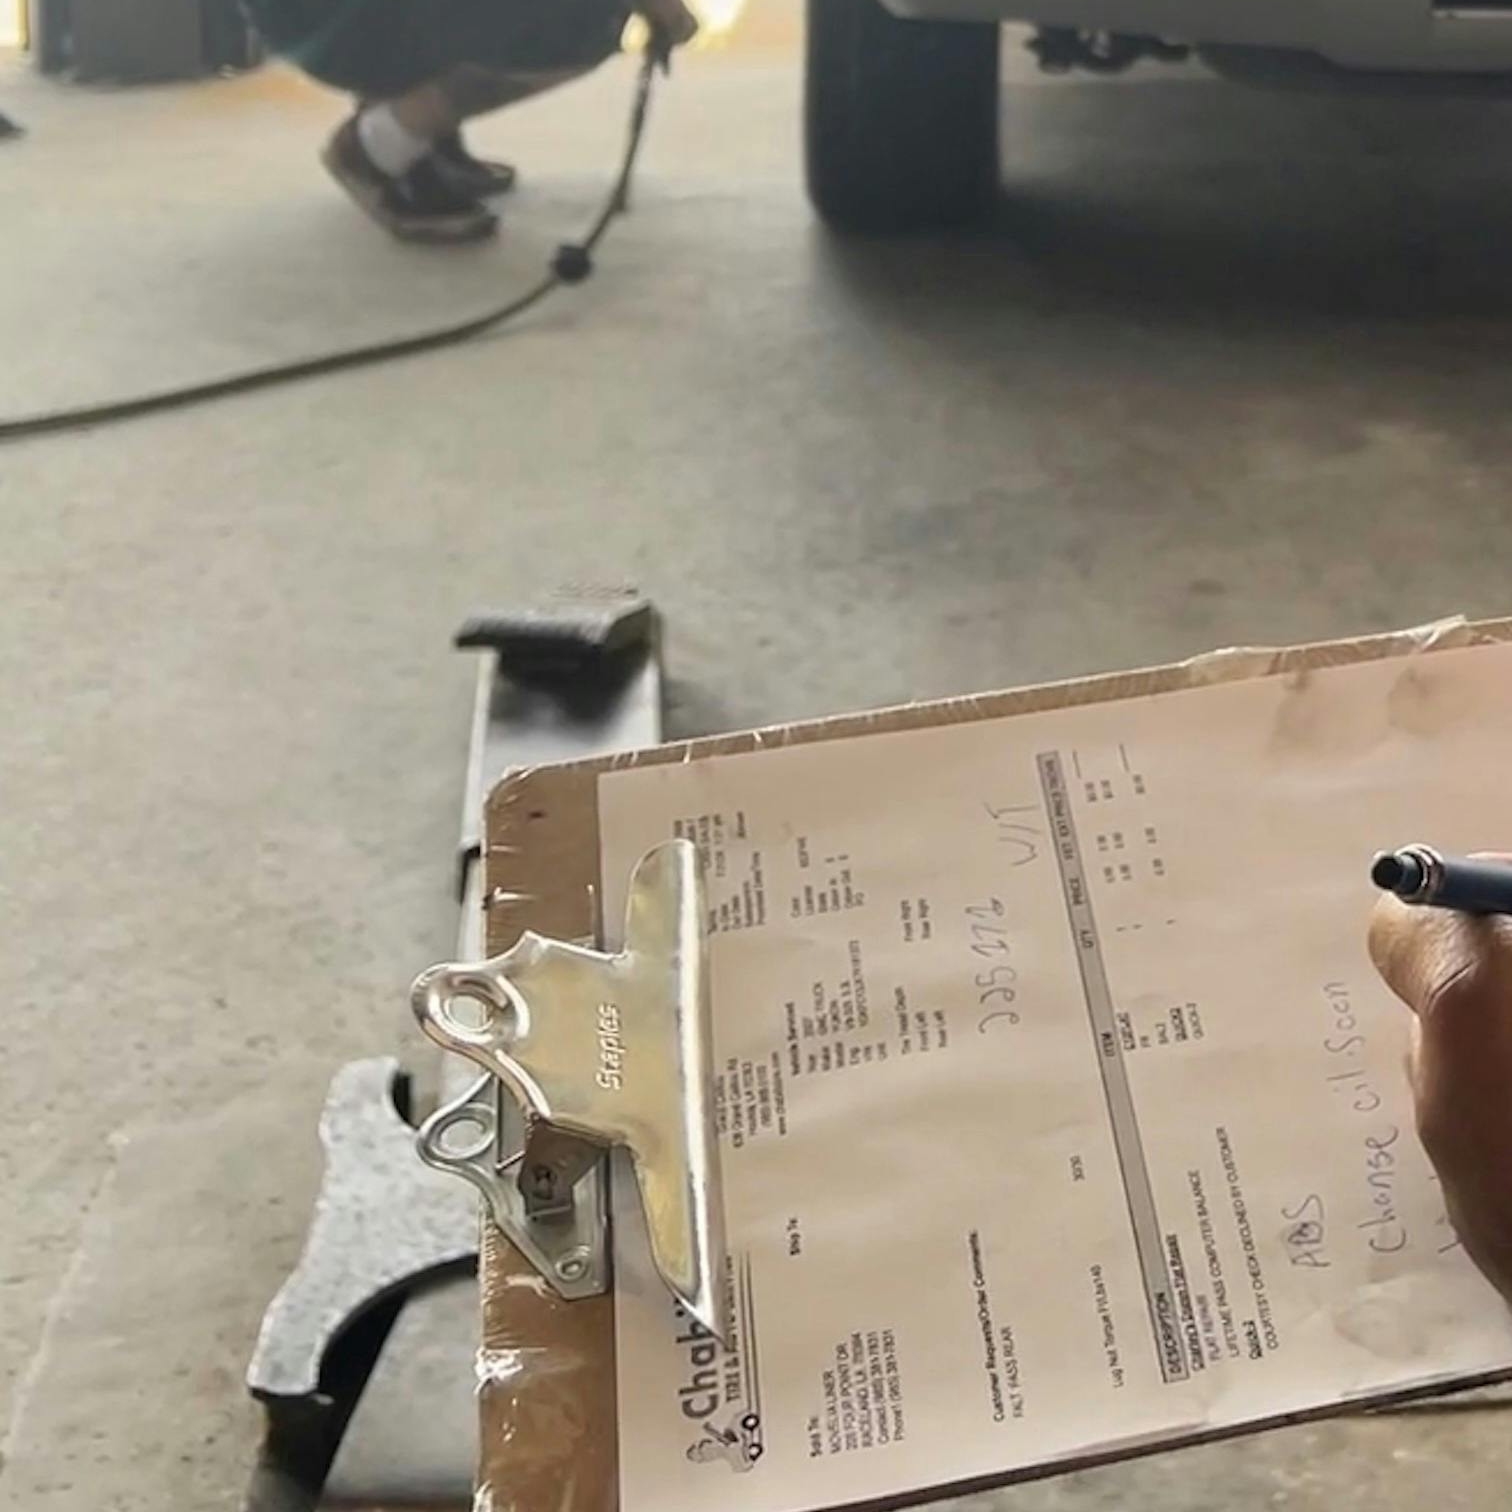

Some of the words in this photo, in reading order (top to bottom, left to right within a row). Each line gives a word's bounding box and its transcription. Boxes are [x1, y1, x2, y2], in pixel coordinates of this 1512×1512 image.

[595, 1003, 626, 1090] Staples
[1101, 1032, 1114, 1056] ITEM
[1216, 1127, 1238, 1183] CUSTOMER
[1188, 1170, 1208, 1217] BALANCE
[1199, 1218, 1222, 1278] COMPUTER
[1233, 1199, 1255, 1252] DECLINED
[1247, 1253, 1264, 1290] CHECK
[1154, 1292, 1182, 1374] DESCRIPTION
[1218, 1309, 1240, 1358] LIFETIME
[1255, 1292, 1279, 1350] COURTESY
[674, 1294, 720, 1420] Chab
[989, 1372, 1005, 1422] Customer
